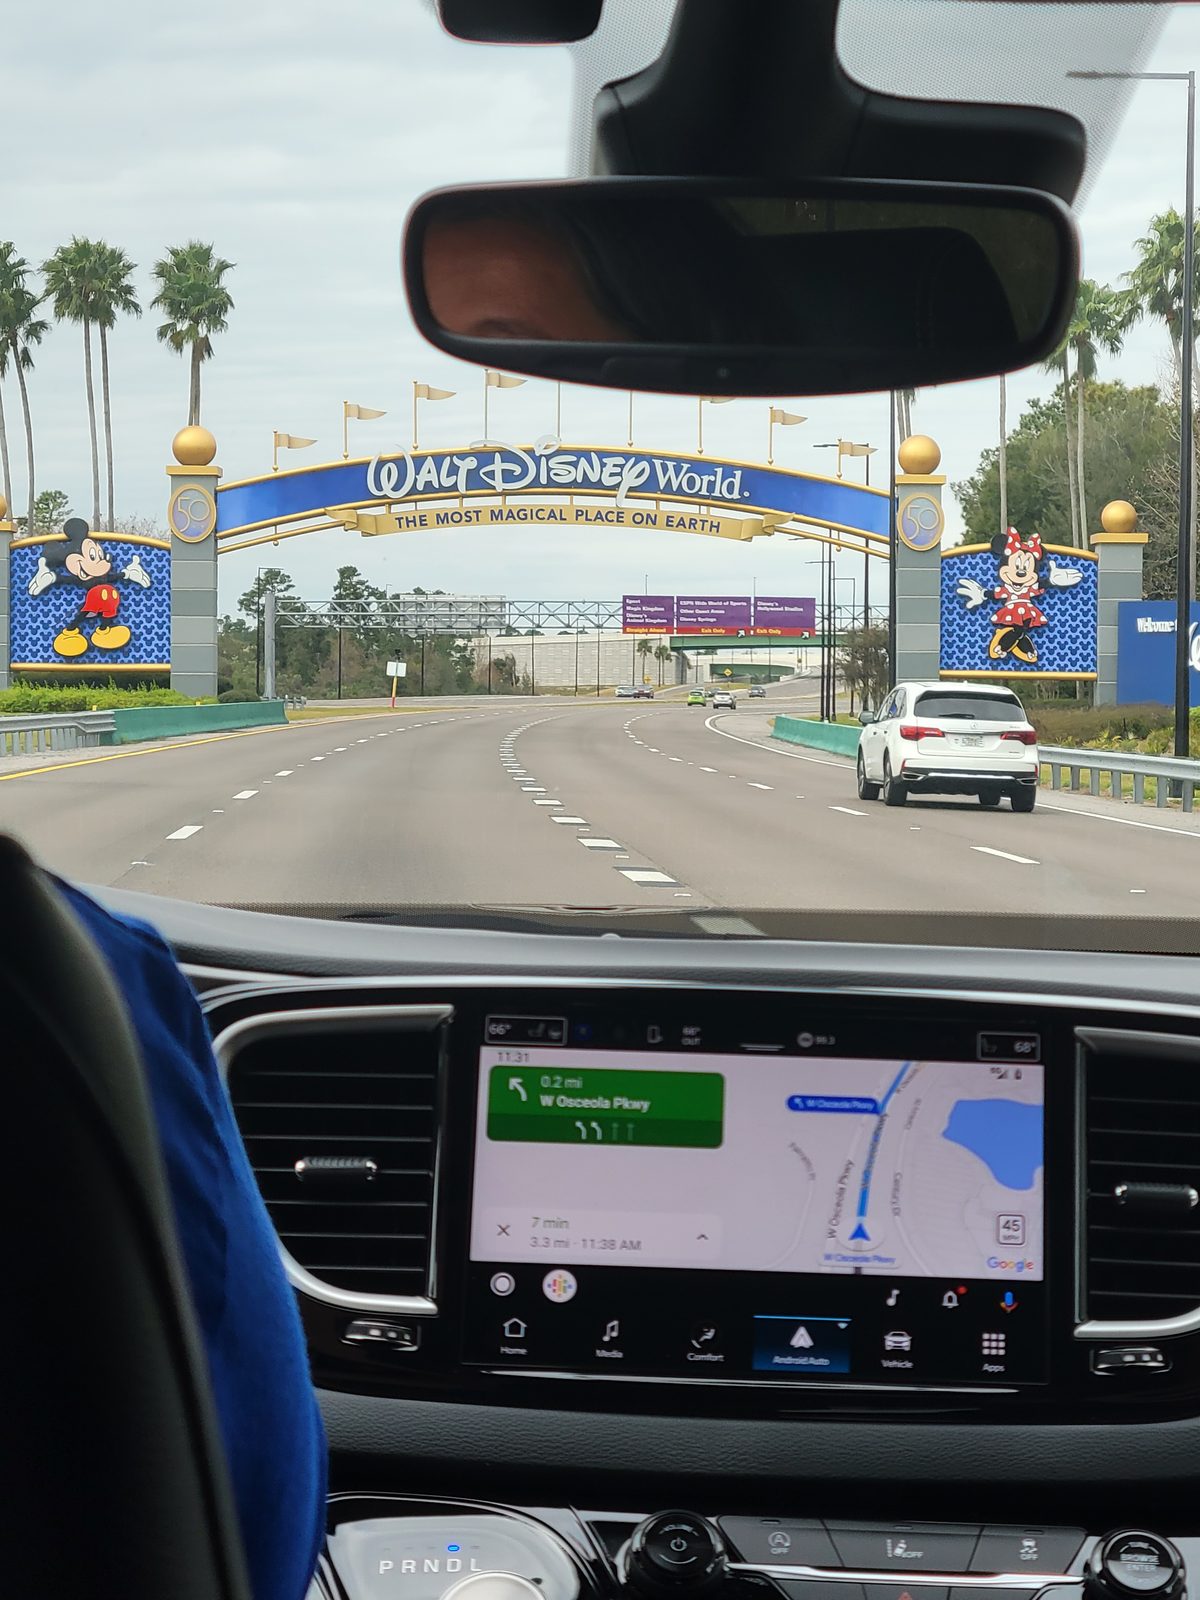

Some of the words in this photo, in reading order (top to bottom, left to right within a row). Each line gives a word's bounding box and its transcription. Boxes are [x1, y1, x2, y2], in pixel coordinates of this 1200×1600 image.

[175, 497, 210, 534] 50
[395, 514, 428, 529] THE
[436, 509, 482, 526] MOST
[490, 508, 567, 522] MAGICAL
[575, 509, 625, 523] PLACE
[632, 511, 657, 526] ON
[665, 514, 721, 533] EARTH
[905, 506, 940, 540] 50
[541, 1076, 561, 1088] 0.2
[564, 1077, 583, 1089] mi
[540, 1094, 555, 1107] W
[556, 1095, 610, 1109] Osceola
[613, 1098, 651, 1113] Pkwy
[531, 1217, 541, 1228] 7
[543, 1218, 569, 1229] min
[1002, 1219, 1020, 1232] 45
[529, 1237, 551, 1248] 3.3
[553, 1238, 570, 1249] mi
[581, 1238, 616, 1250] 11:38
[619, 1240, 642, 1250] AM
[987, 1255, 1034, 1273] Google
[500, 1346, 528, 1356] Home
[596, 1349, 624, 1359] Media
[687, 1351, 725, 1363] Comfort
[773, 1355, 808, 1366] Android
[808, 1356, 830, 1366] Auto
[881, 1358, 914, 1369] Vehicle
[982, 1362, 1005, 1374] Apps
[906, 1551, 924, 1559] OFF
[1021, 1553, 1038, 1561] OFF
[1119, 1553, 1159, 1563] BROWSE
[1127, 1564, 1157, 1573] ENTER
